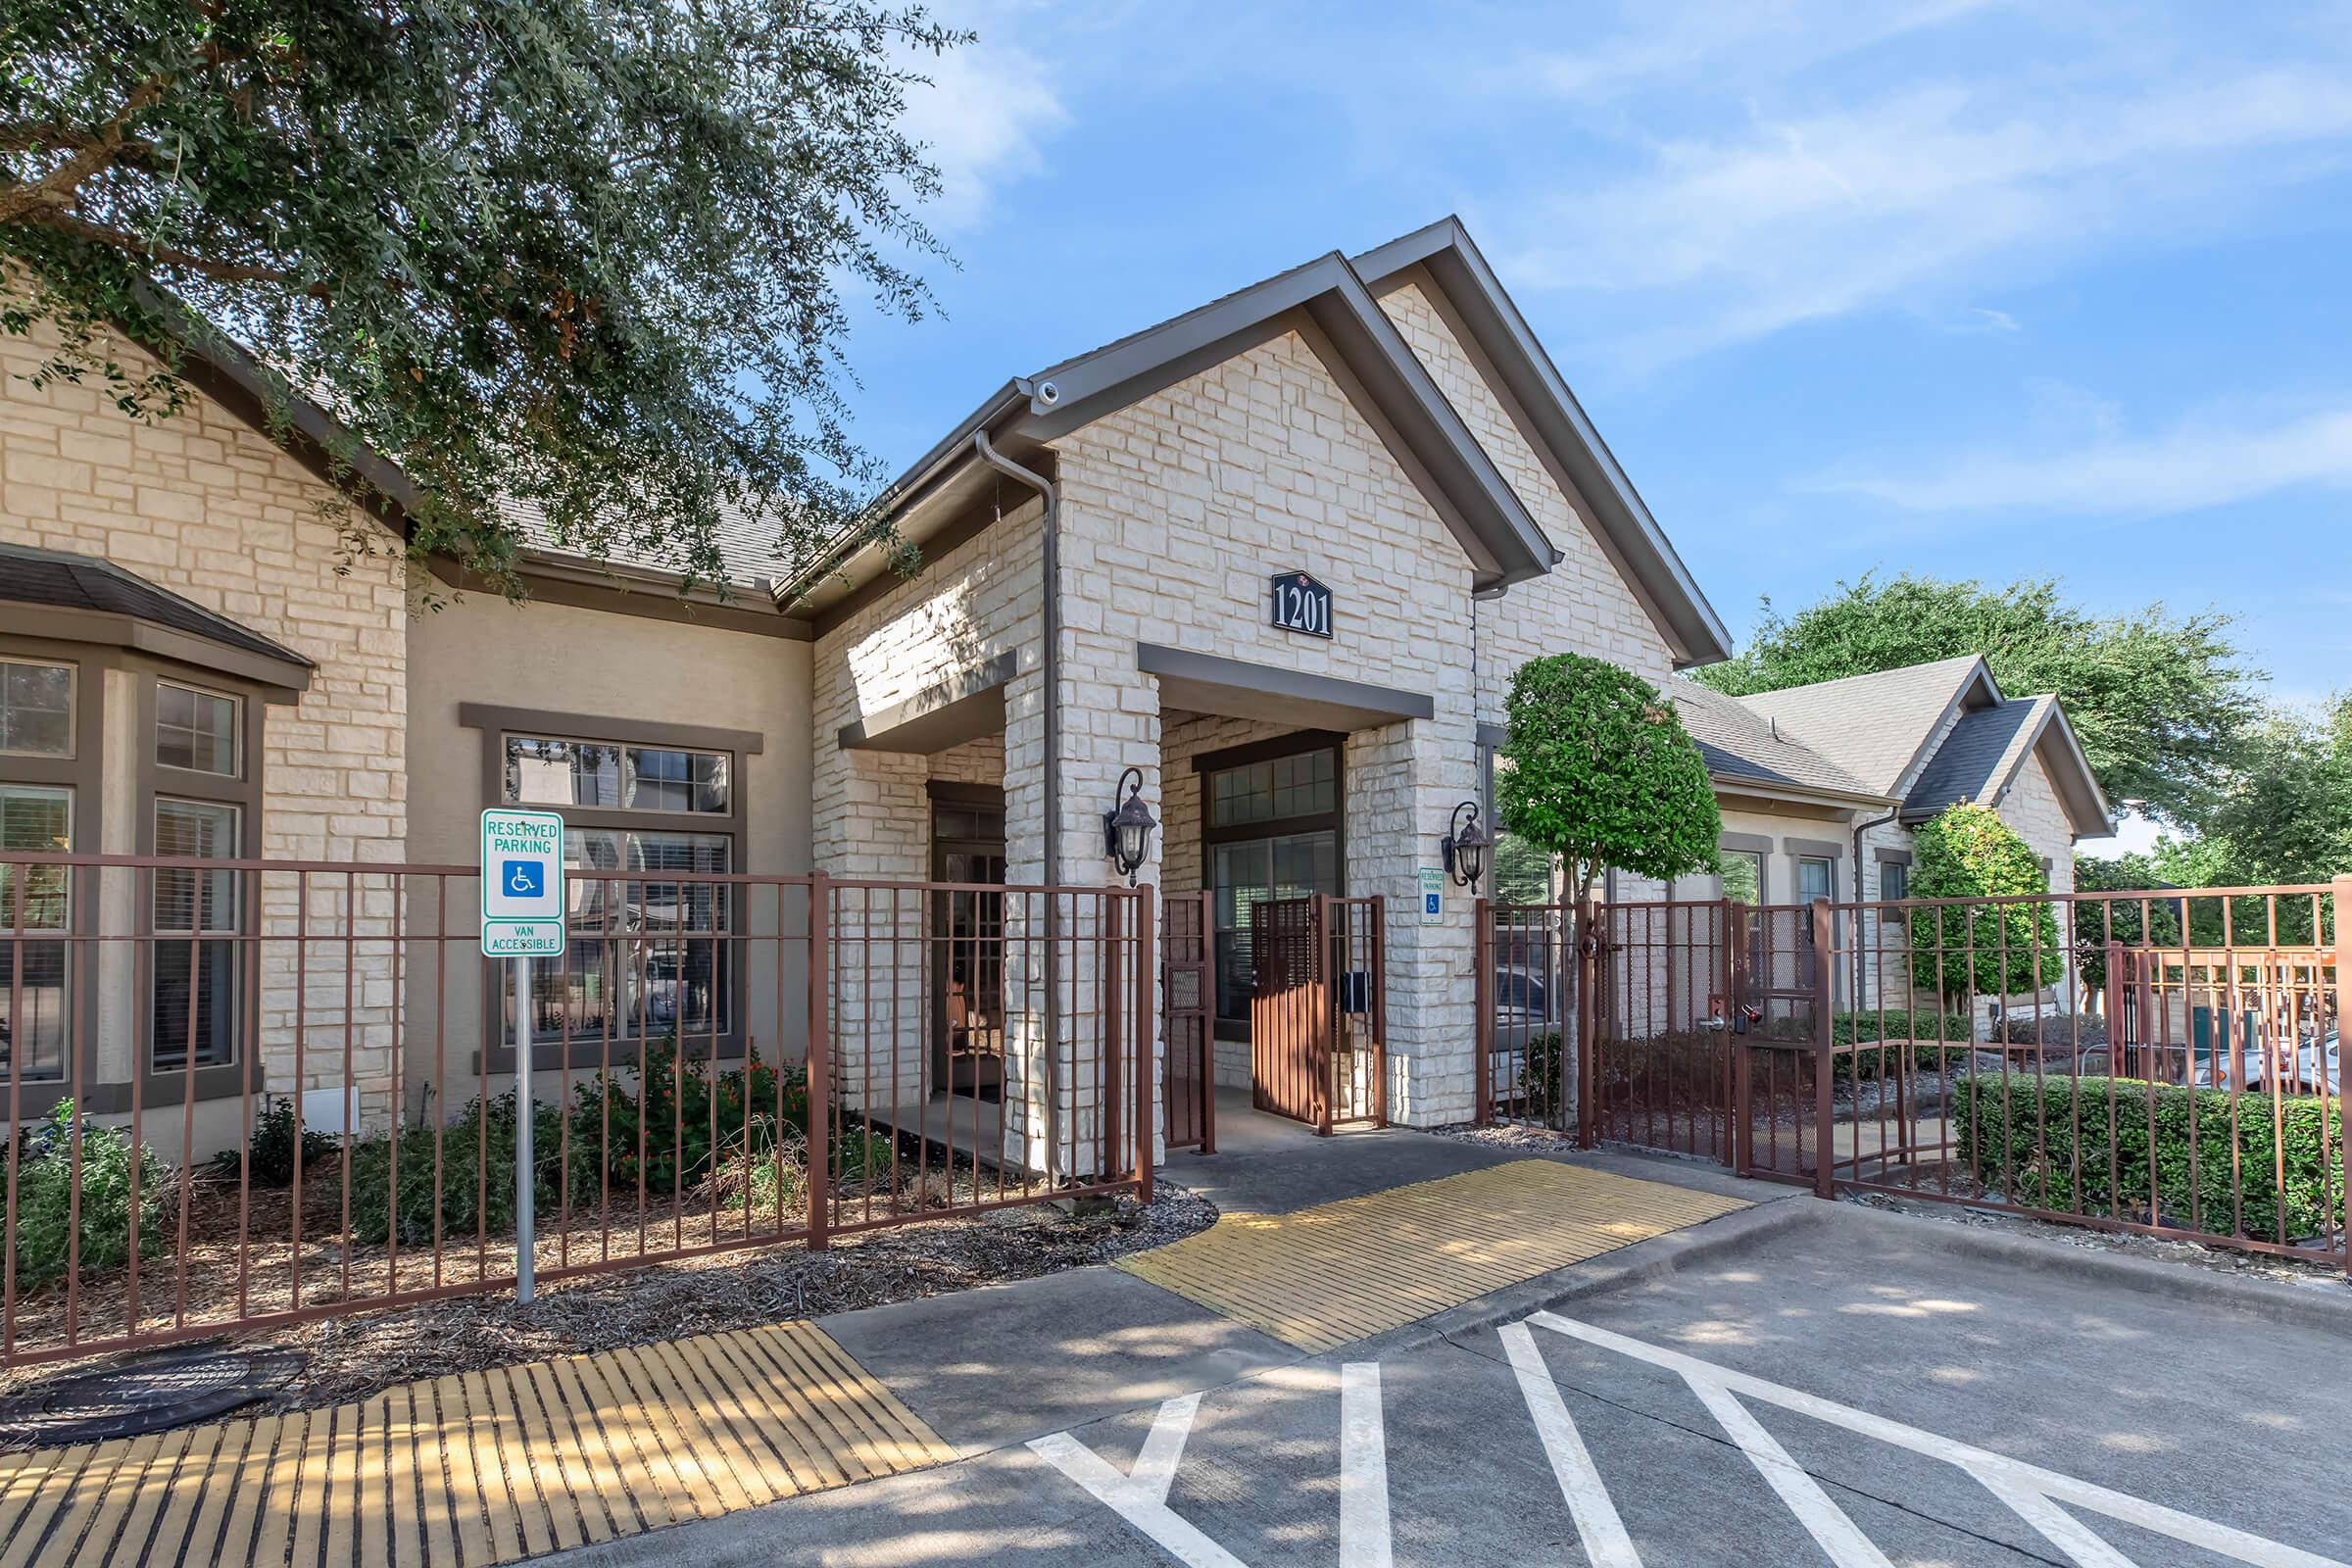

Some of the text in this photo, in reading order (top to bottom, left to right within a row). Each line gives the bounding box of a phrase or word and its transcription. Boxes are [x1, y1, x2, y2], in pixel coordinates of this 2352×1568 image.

[1275, 584, 1330, 635] 1201
[488, 821, 557, 838] RESERVED
[494, 839, 551, 854] PARKING
[514, 926, 534, 937] VAN
[492, 938, 556, 950] ACCESSIBLE
